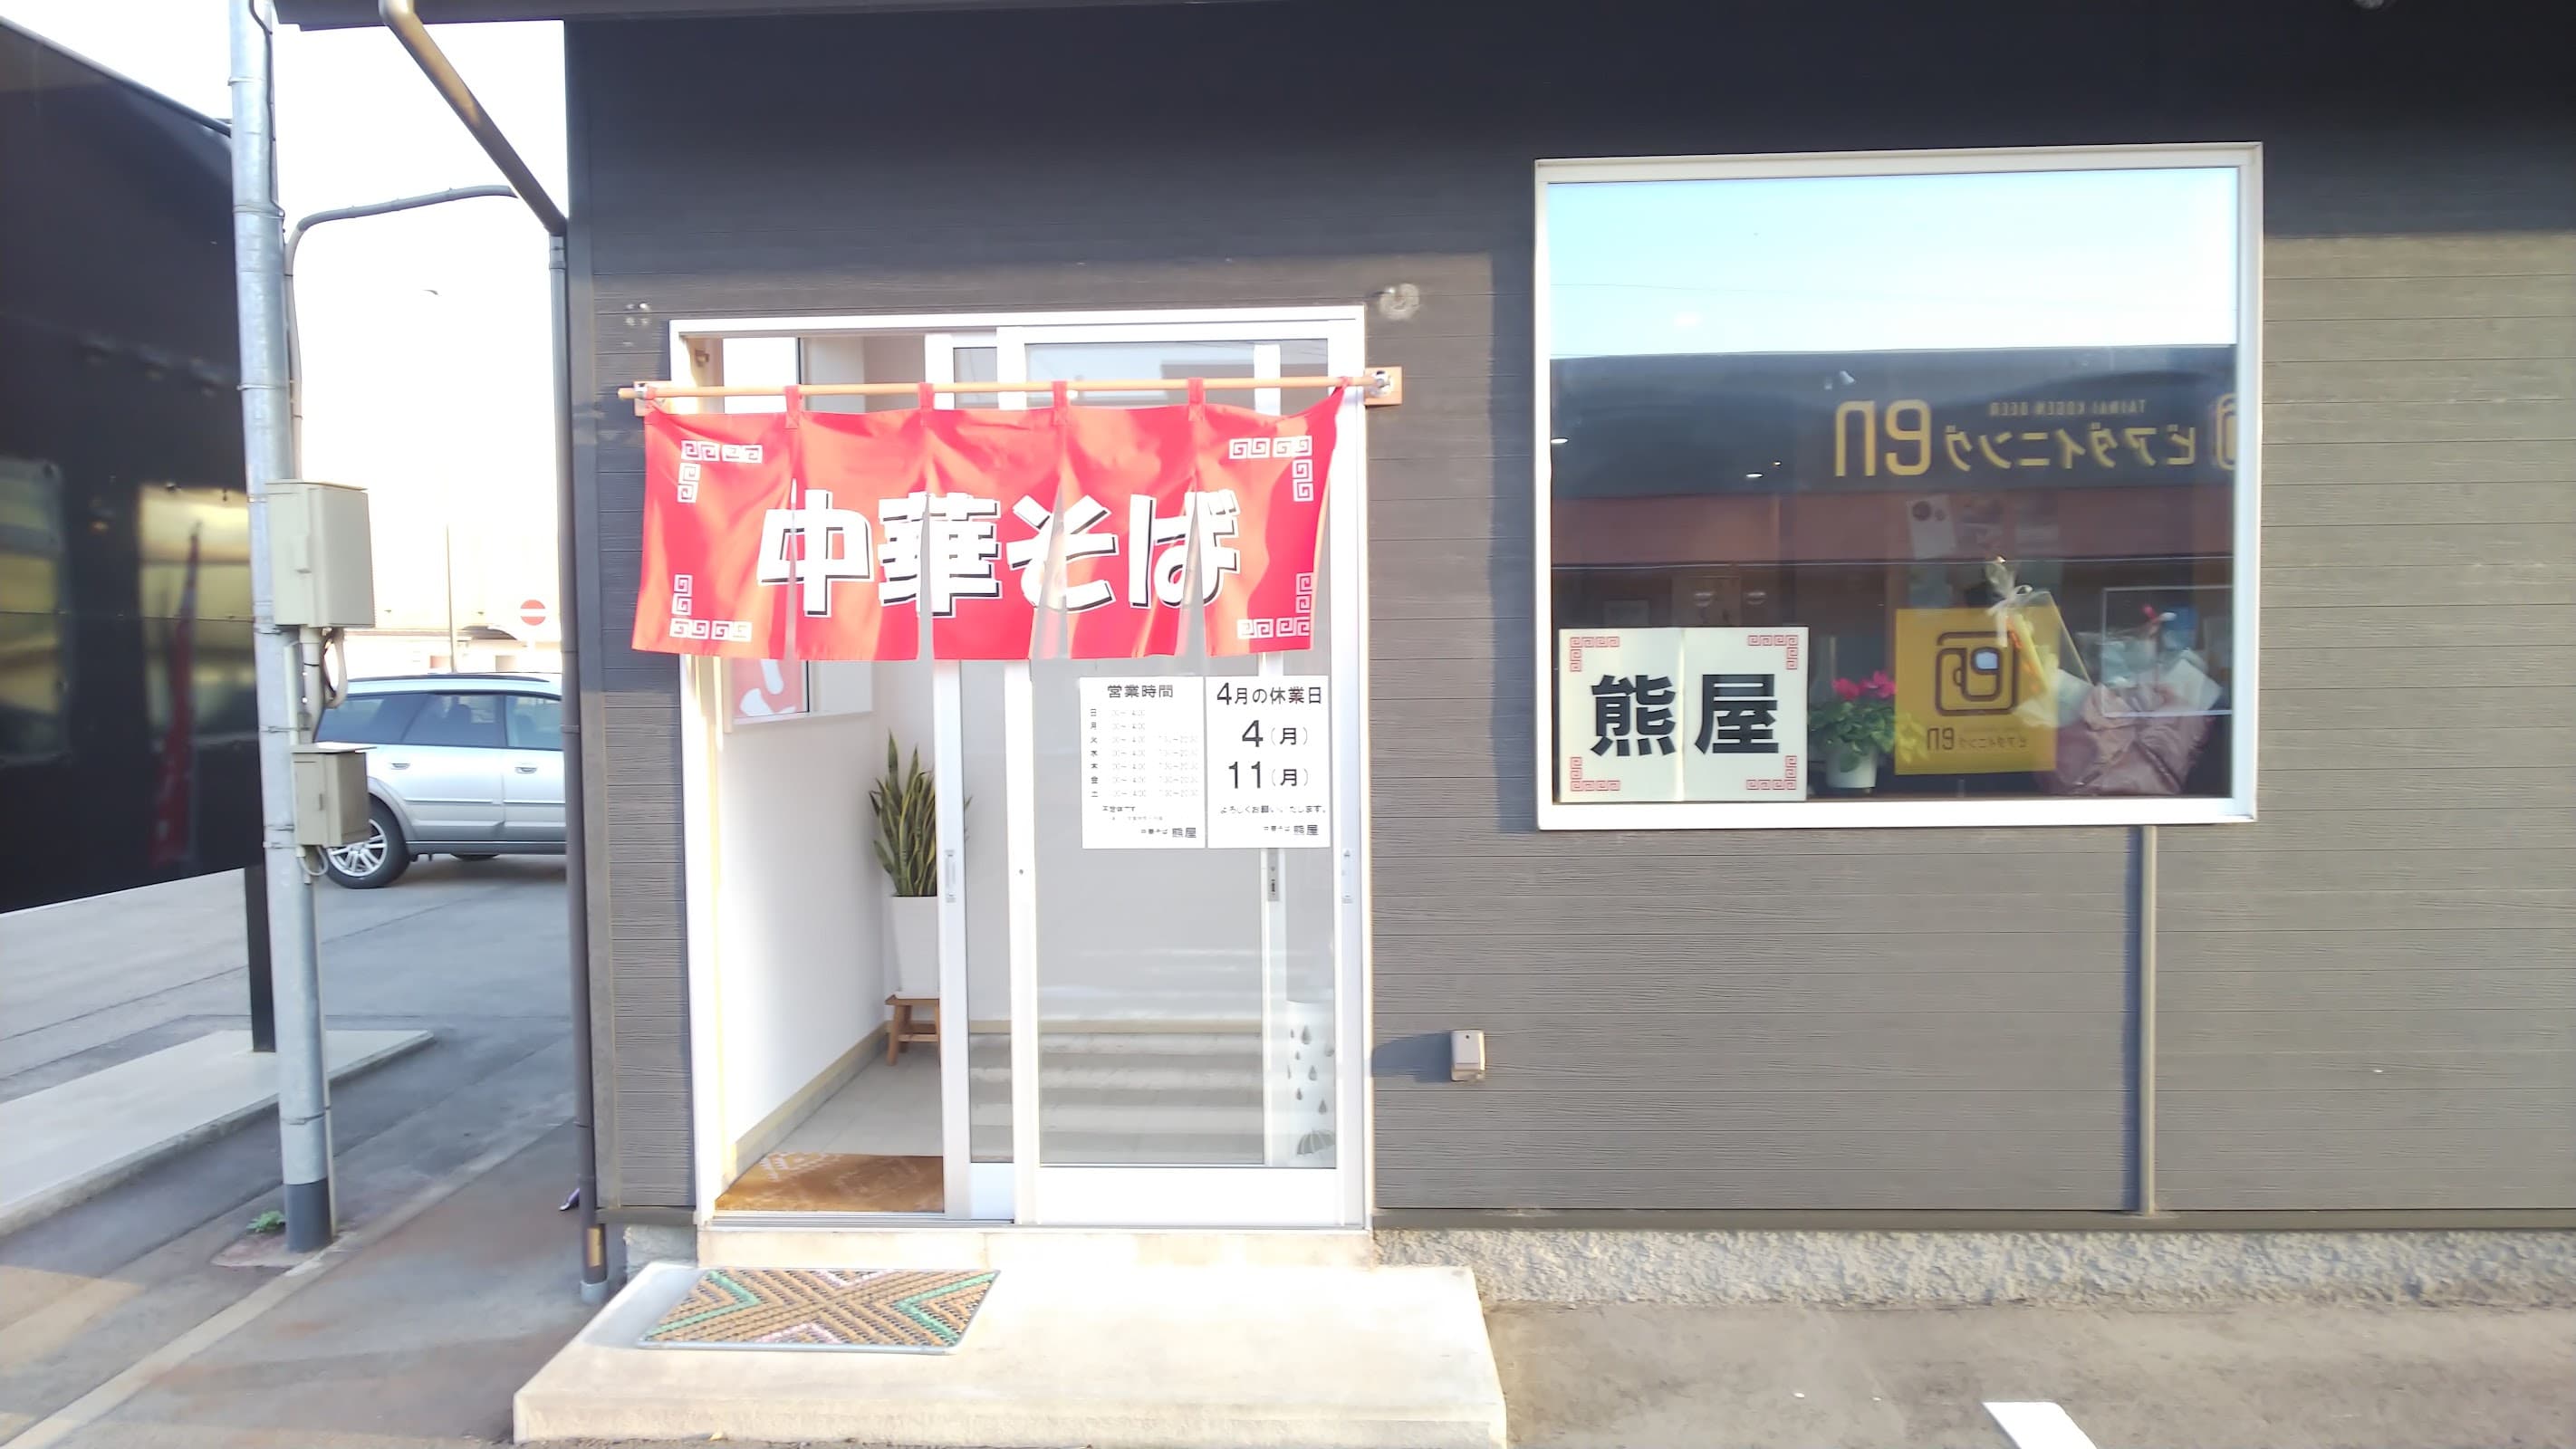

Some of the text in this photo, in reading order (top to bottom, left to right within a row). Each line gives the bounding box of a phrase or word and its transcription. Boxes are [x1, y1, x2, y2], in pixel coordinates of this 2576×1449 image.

[757, 489, 1241, 617] 中華そば
[1108, 685, 1174, 698] 営業時間
[1216, 682, 1322, 705] 4月の休業日
[1591, 674, 1779, 756] 熊屋
